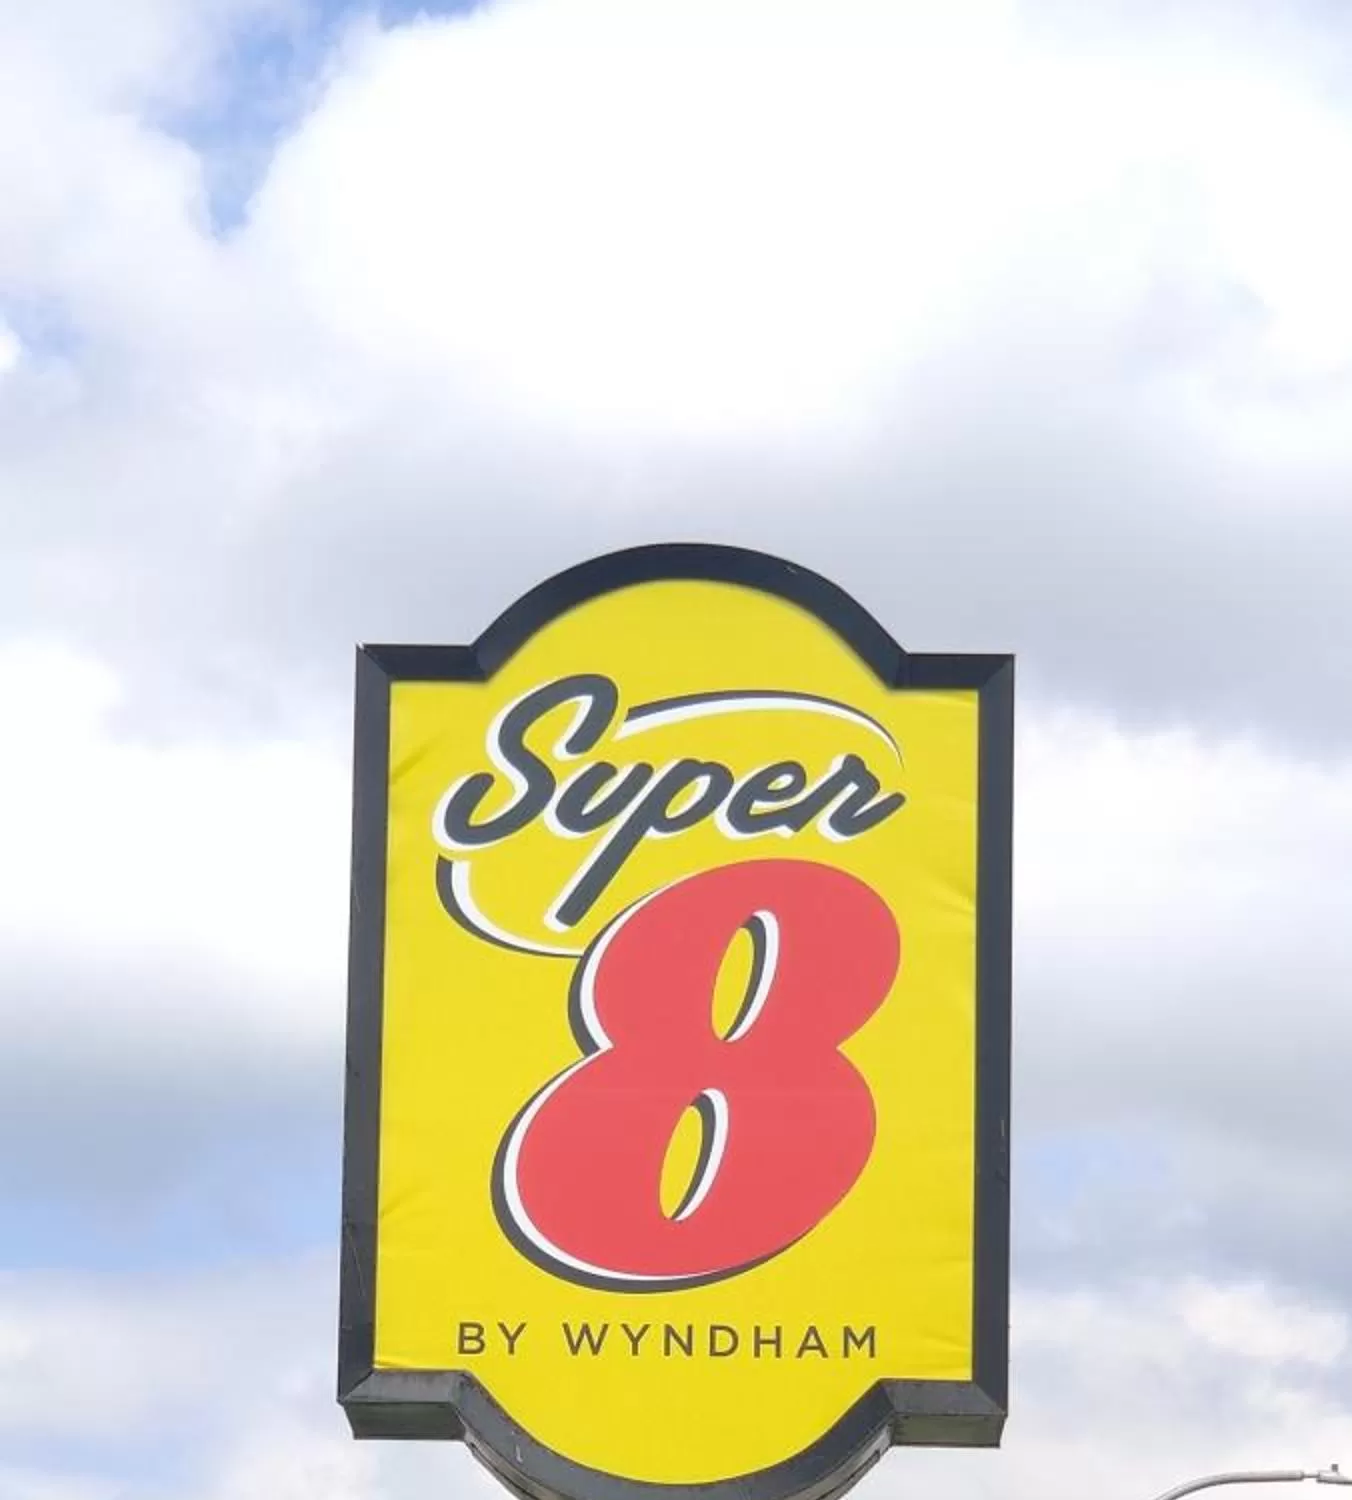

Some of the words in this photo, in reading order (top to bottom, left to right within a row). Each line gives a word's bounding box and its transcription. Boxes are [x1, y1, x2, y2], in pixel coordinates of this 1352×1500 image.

[436, 673, 906, 929] Super
[491, 858, 901, 1294] 8
[458, 1322, 526, 1355] BY
[562, 1324, 876, 1358] WYNDHAM
